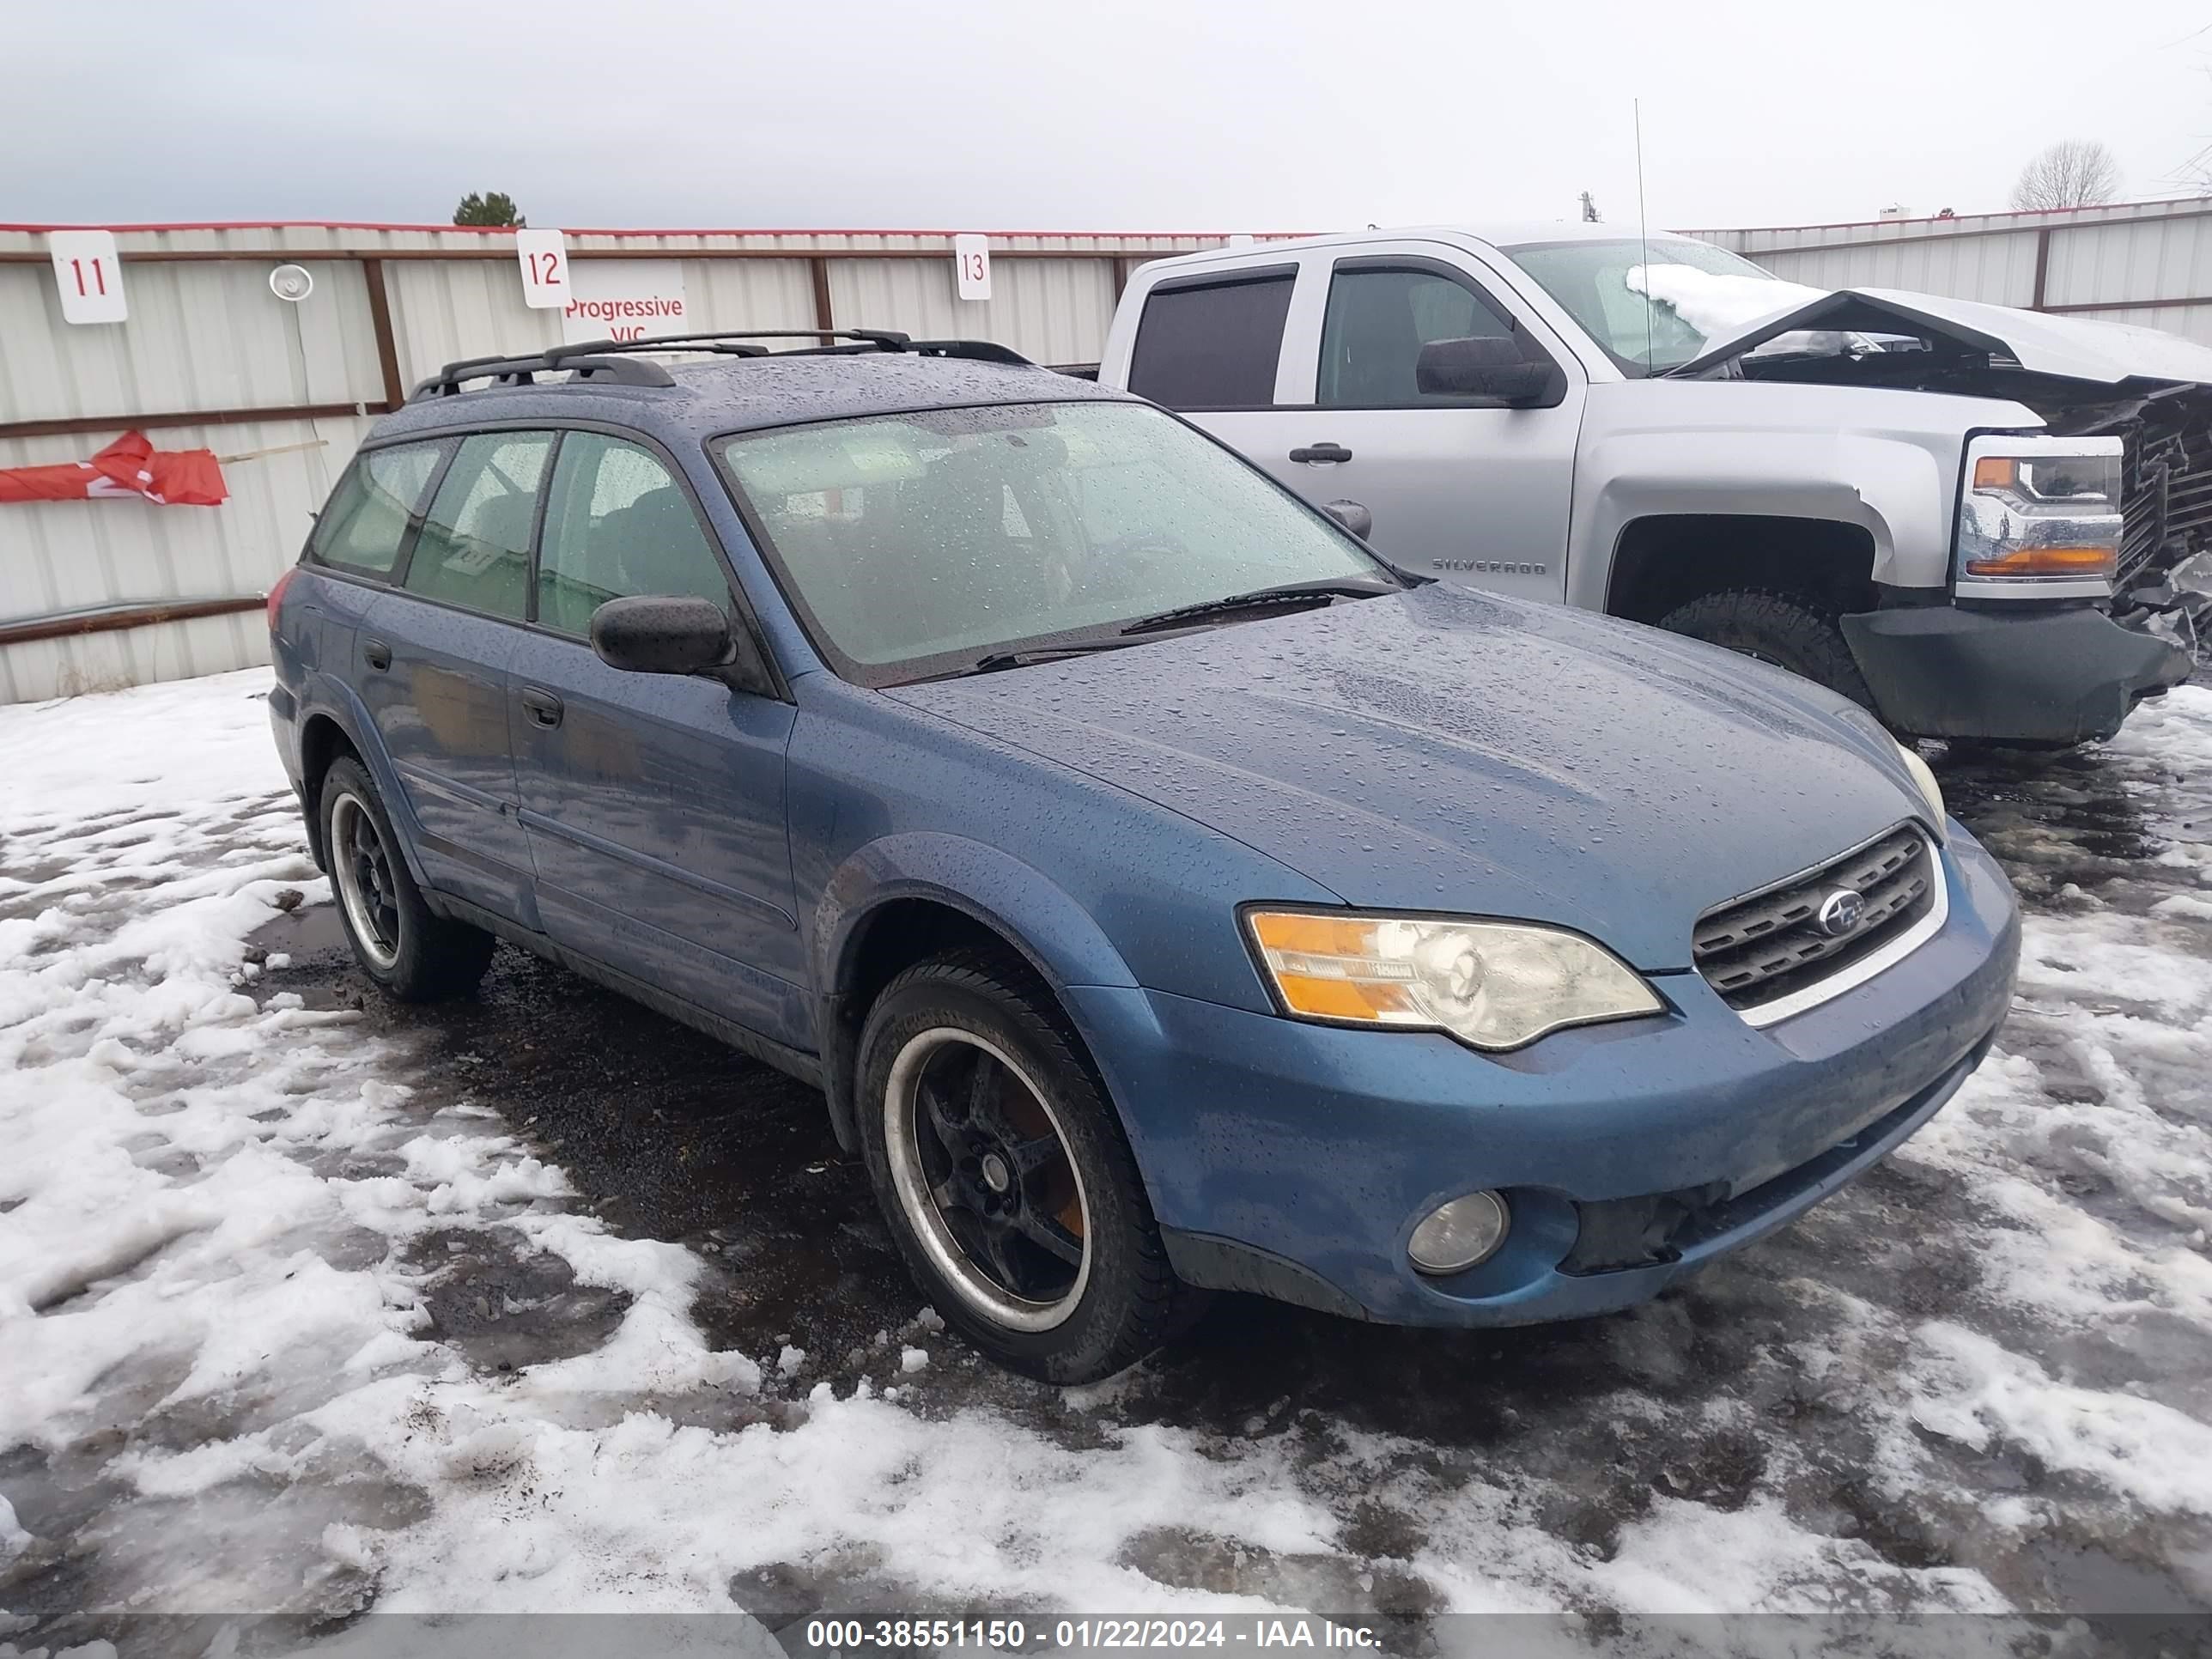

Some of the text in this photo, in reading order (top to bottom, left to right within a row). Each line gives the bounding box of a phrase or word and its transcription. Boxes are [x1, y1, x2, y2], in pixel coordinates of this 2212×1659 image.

[70, 258, 106, 296] 11
[529, 252, 561, 285] 12
[963, 254, 984, 281] 13
[565, 295, 683, 321] Progressive
[1432, 558, 1546, 574] SILVERADO
